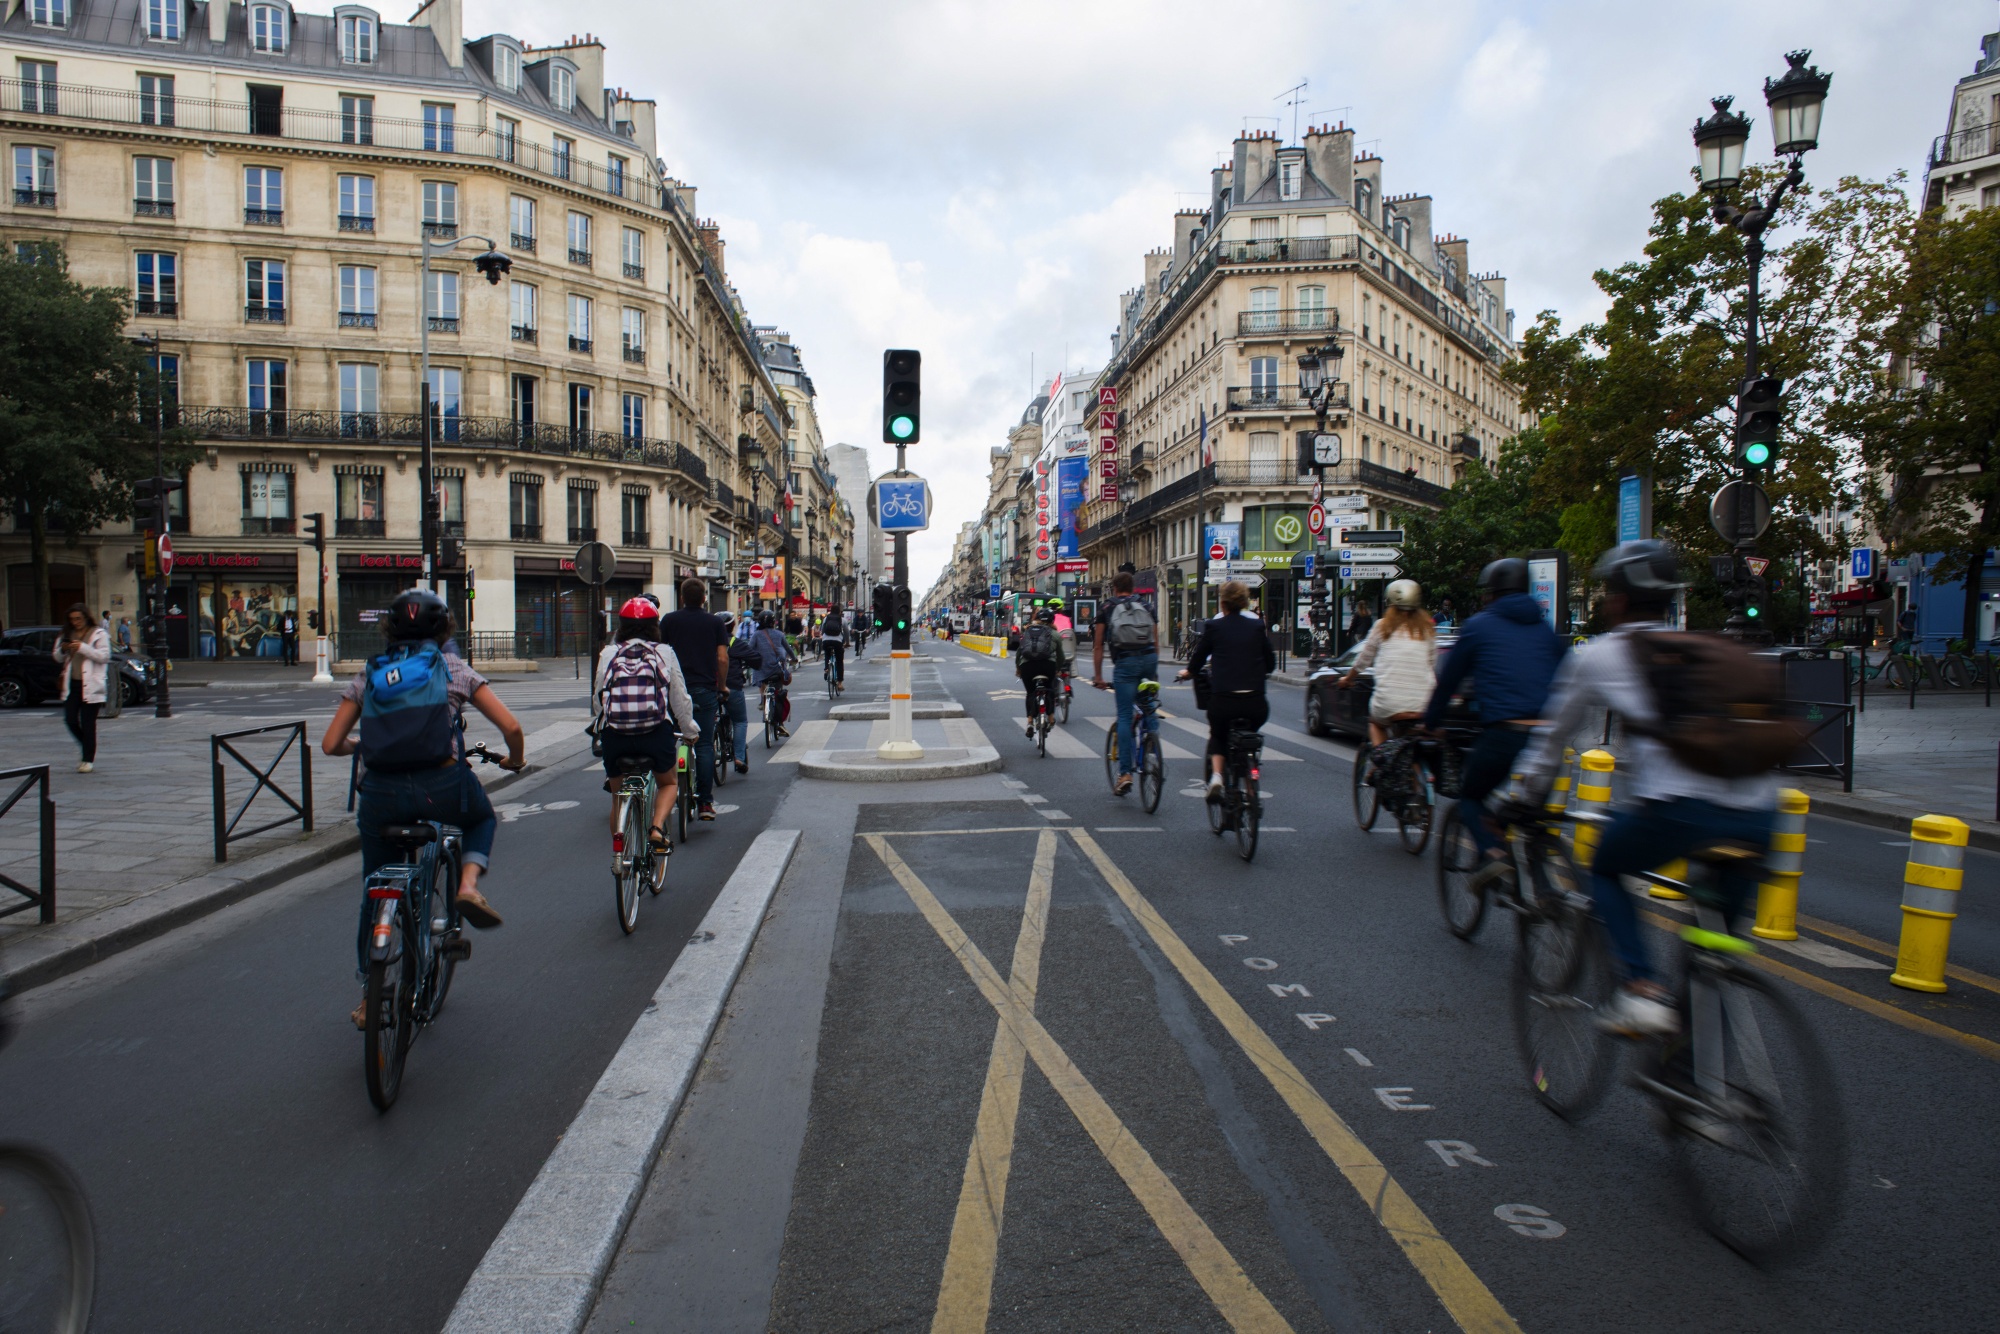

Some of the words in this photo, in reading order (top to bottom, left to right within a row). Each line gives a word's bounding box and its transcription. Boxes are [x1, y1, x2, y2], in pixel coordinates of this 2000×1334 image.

[1100, 387, 1117, 501] ANDRÉ
[1035, 460, 1050, 561] LISSAC
[1205, 527, 1239, 538] Toujours
[208, 553, 261, 567] Locker
[360, 554, 393, 567] Foot
[560, 558, 576, 571] Foo
[1218, 934, 1567, 1239] POMPIERS
